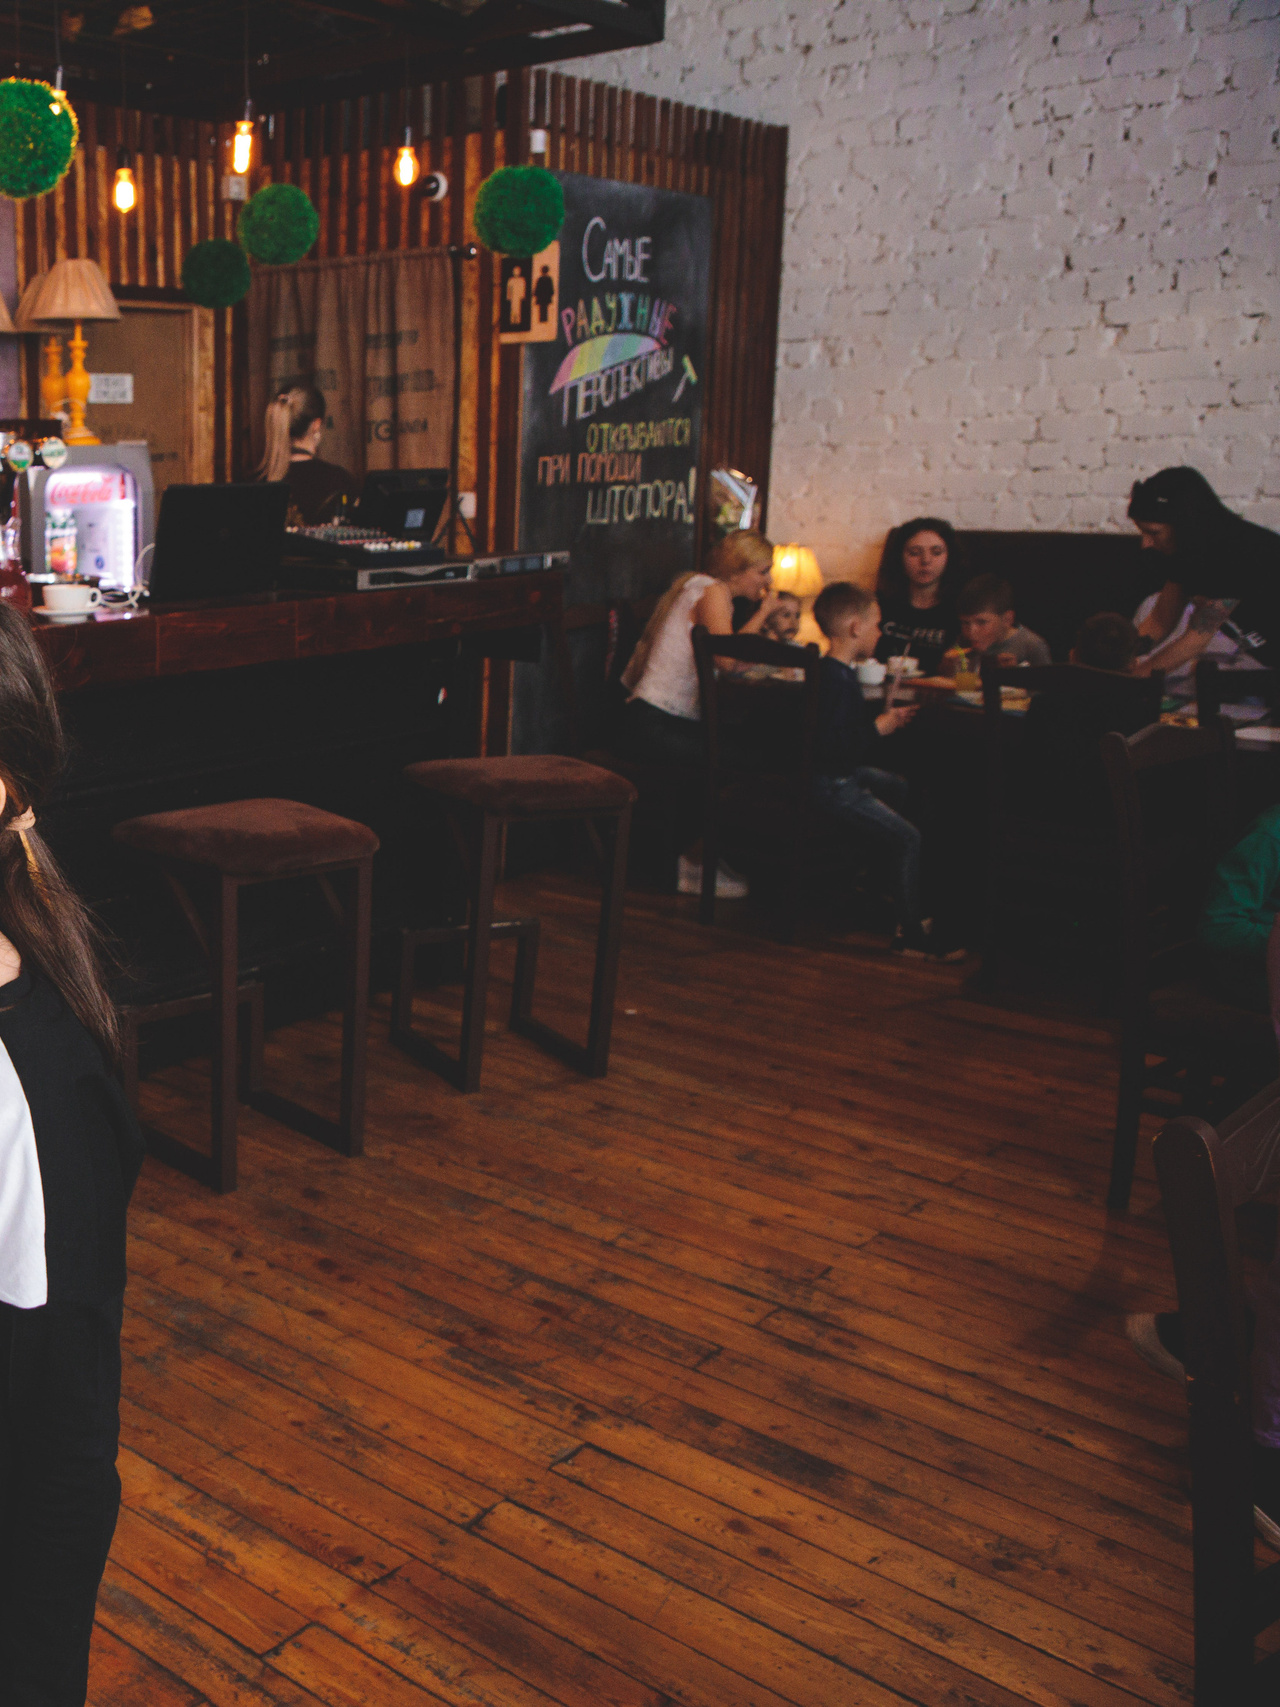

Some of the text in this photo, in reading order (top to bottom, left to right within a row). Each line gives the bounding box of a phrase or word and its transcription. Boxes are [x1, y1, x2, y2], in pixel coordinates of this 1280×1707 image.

[537, 452, 642, 487] ПРИ ПОМОЩИ
[586, 466, 697, 525] ШТОПОРА!
